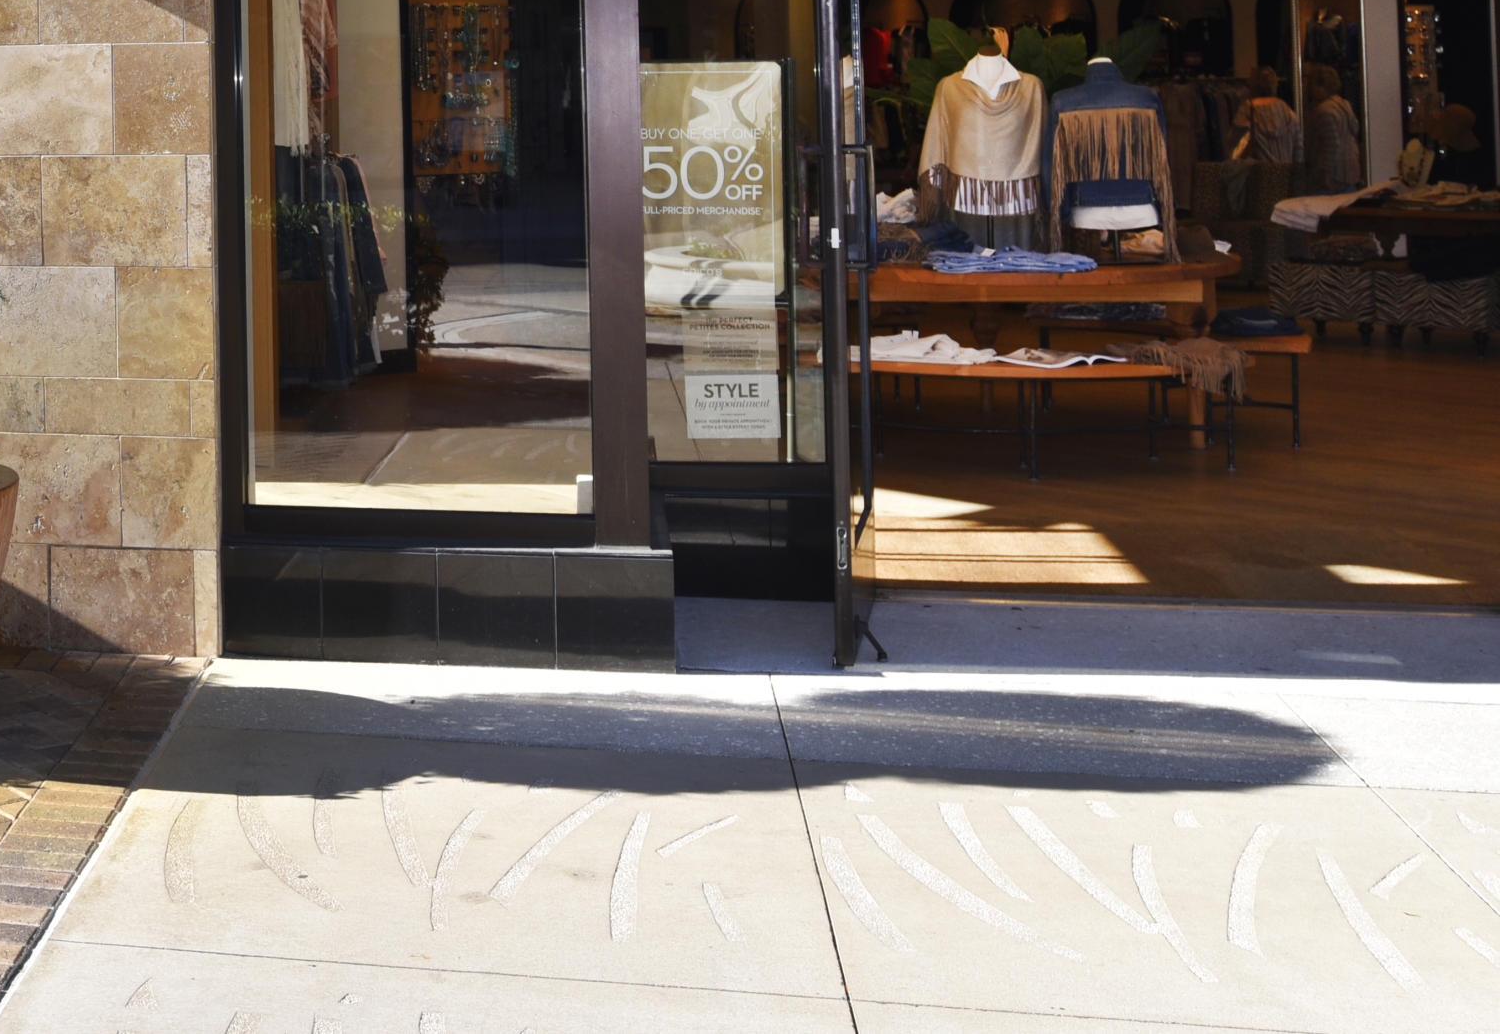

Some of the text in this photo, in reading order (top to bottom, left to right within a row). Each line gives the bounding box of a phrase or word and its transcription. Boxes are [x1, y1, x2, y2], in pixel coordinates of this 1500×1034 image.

[640, 127, 665, 140] BUY
[703, 128, 730, 140] GET
[731, 128, 762, 140] ONE
[642, 145, 764, 200] 50%
[725, 185, 763, 201] OFF
[643, 206, 695, 215] ULL-PRICED
[704, 383, 759, 398] STYLE
[708, 398, 770, 411] appointment
